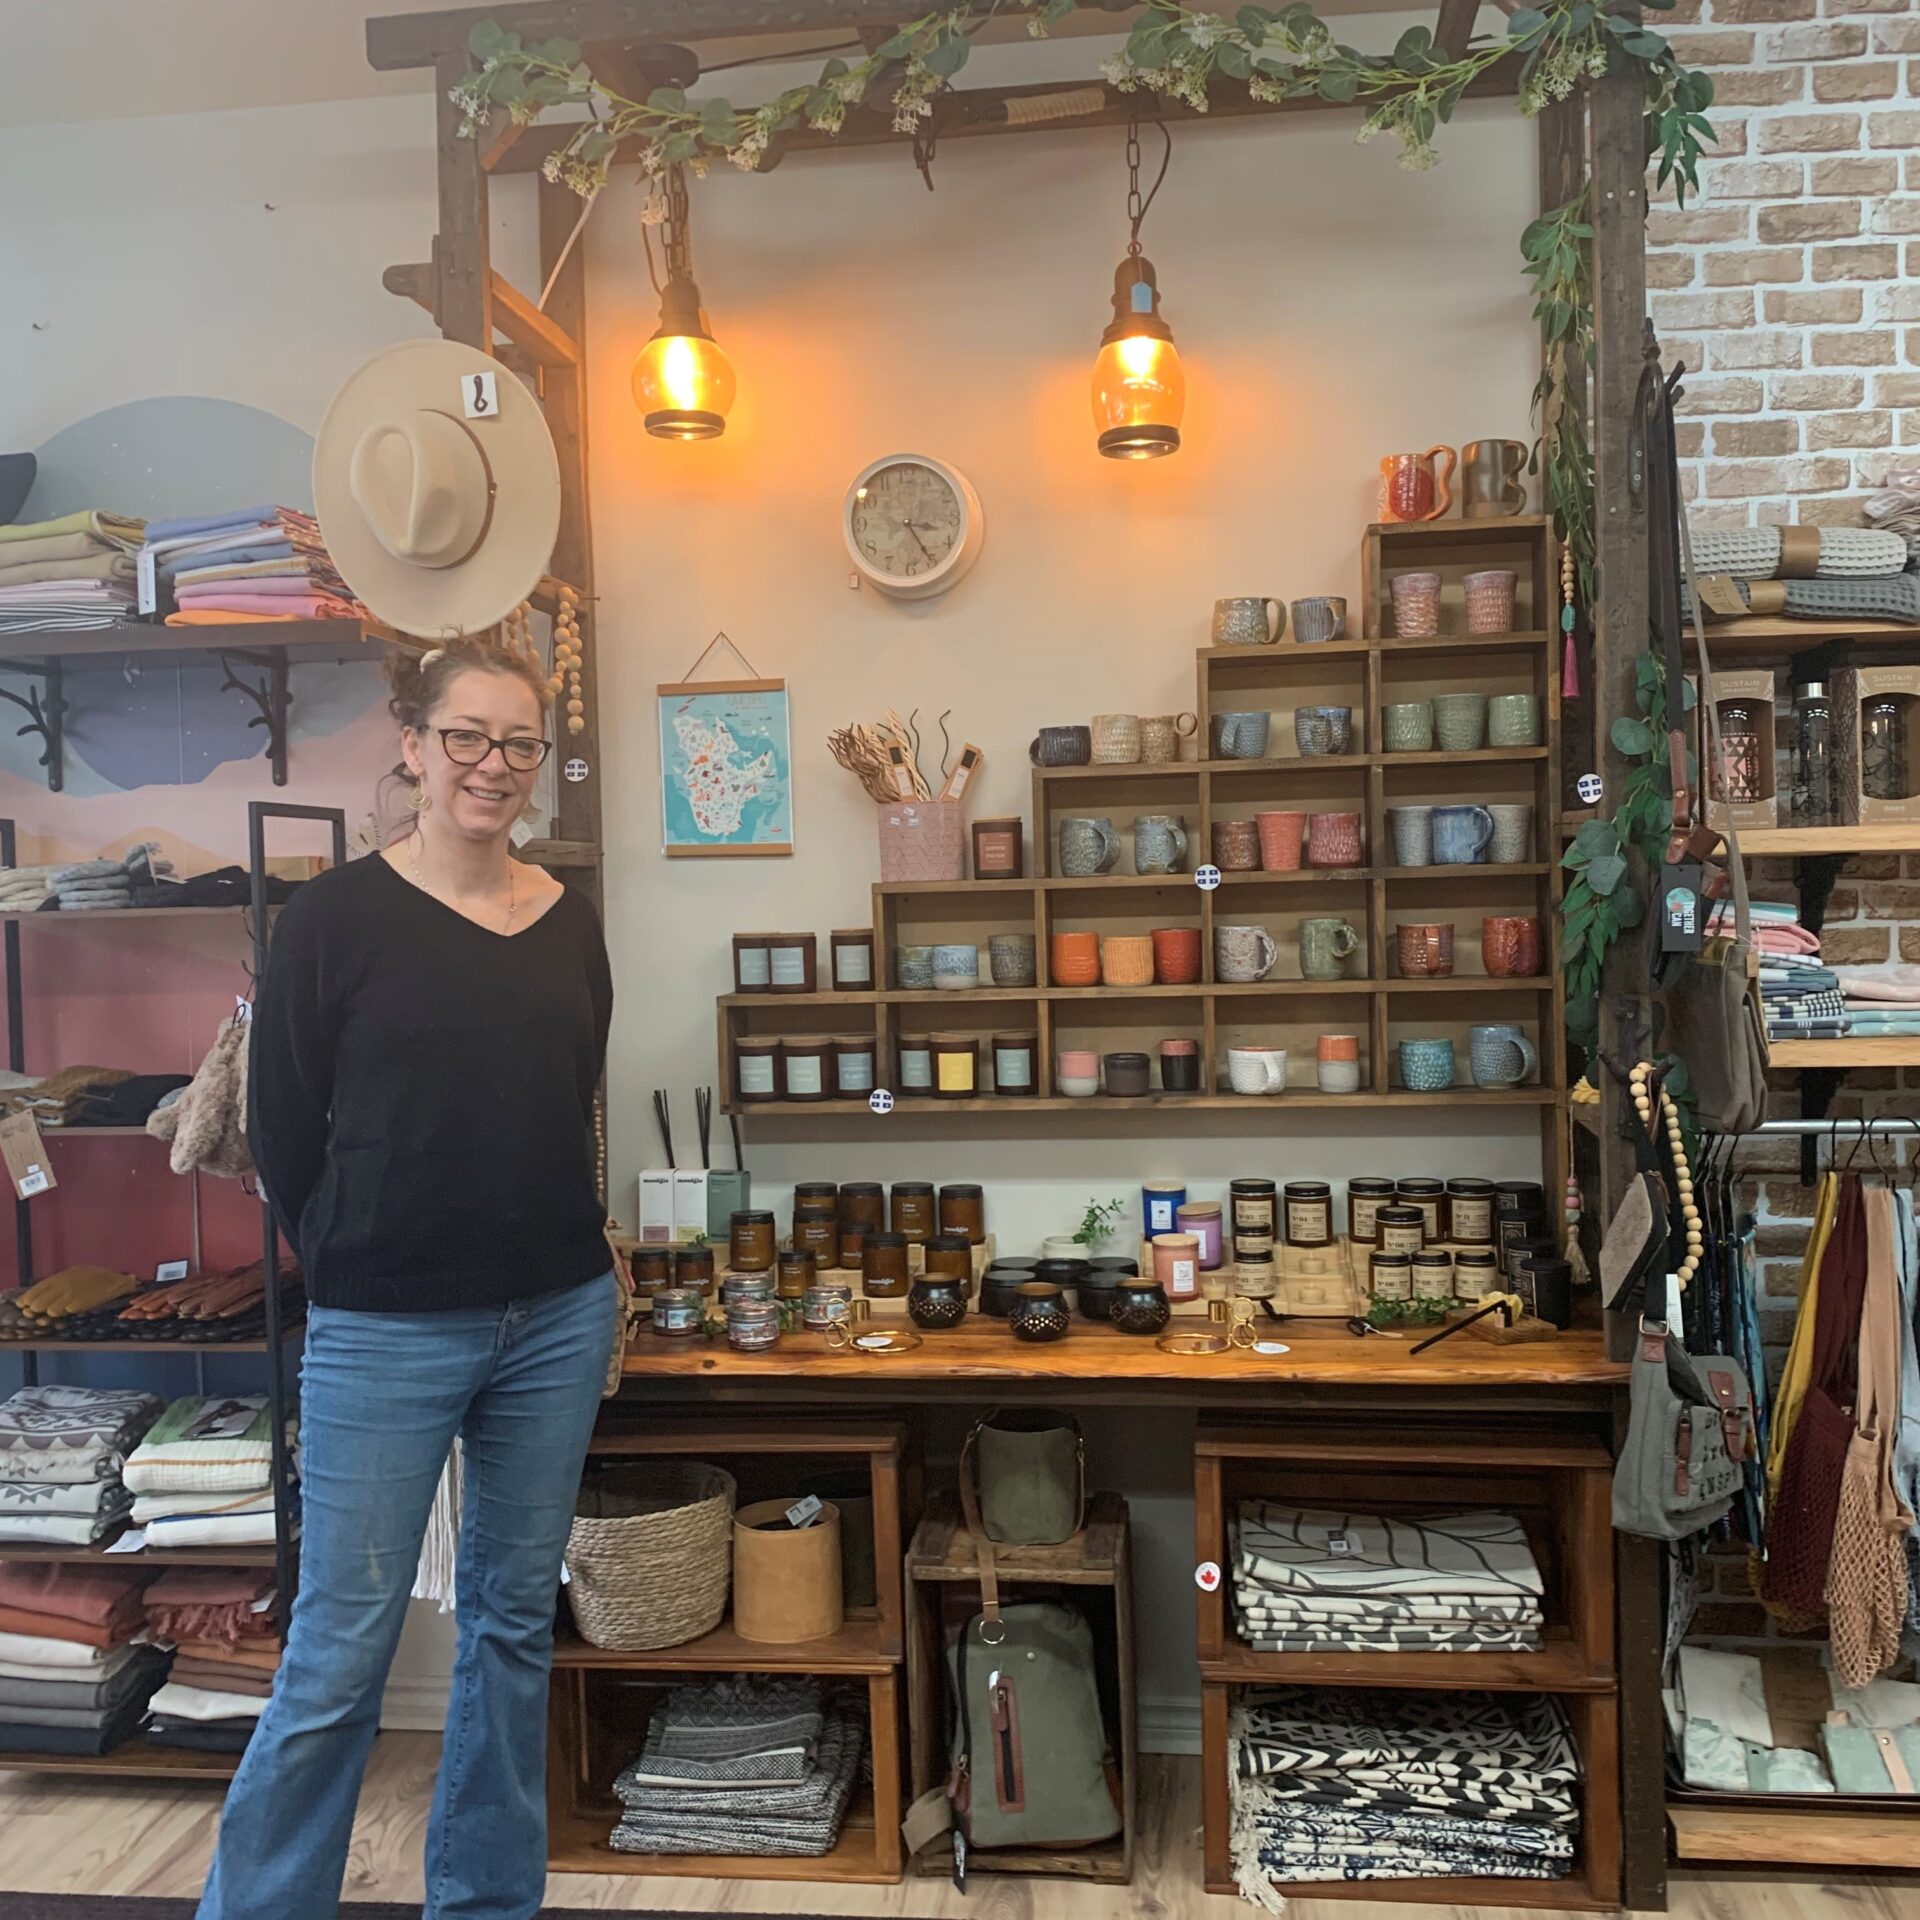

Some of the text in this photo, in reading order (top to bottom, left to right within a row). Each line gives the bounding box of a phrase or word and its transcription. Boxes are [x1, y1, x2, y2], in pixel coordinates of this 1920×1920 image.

[880, 477, 889, 491] 11
[898, 469, 915, 484] 12
[863, 494, 877, 509] 10
[941, 488, 952, 504] 2
[856, 517, 867, 532] 9
[949, 511, 960, 527] 3
[866, 540, 877, 556] 8
[942, 534, 954, 549] 4
[884, 556, 894, 571] 7
[927, 553, 938, 569] 5
[905, 562, 917, 576] 6
[1719, 679, 1760, 688] SUSTAIN
[1872, 673, 1914, 682] SUSTAIN
[1671, 912, 1682, 927] CAN
